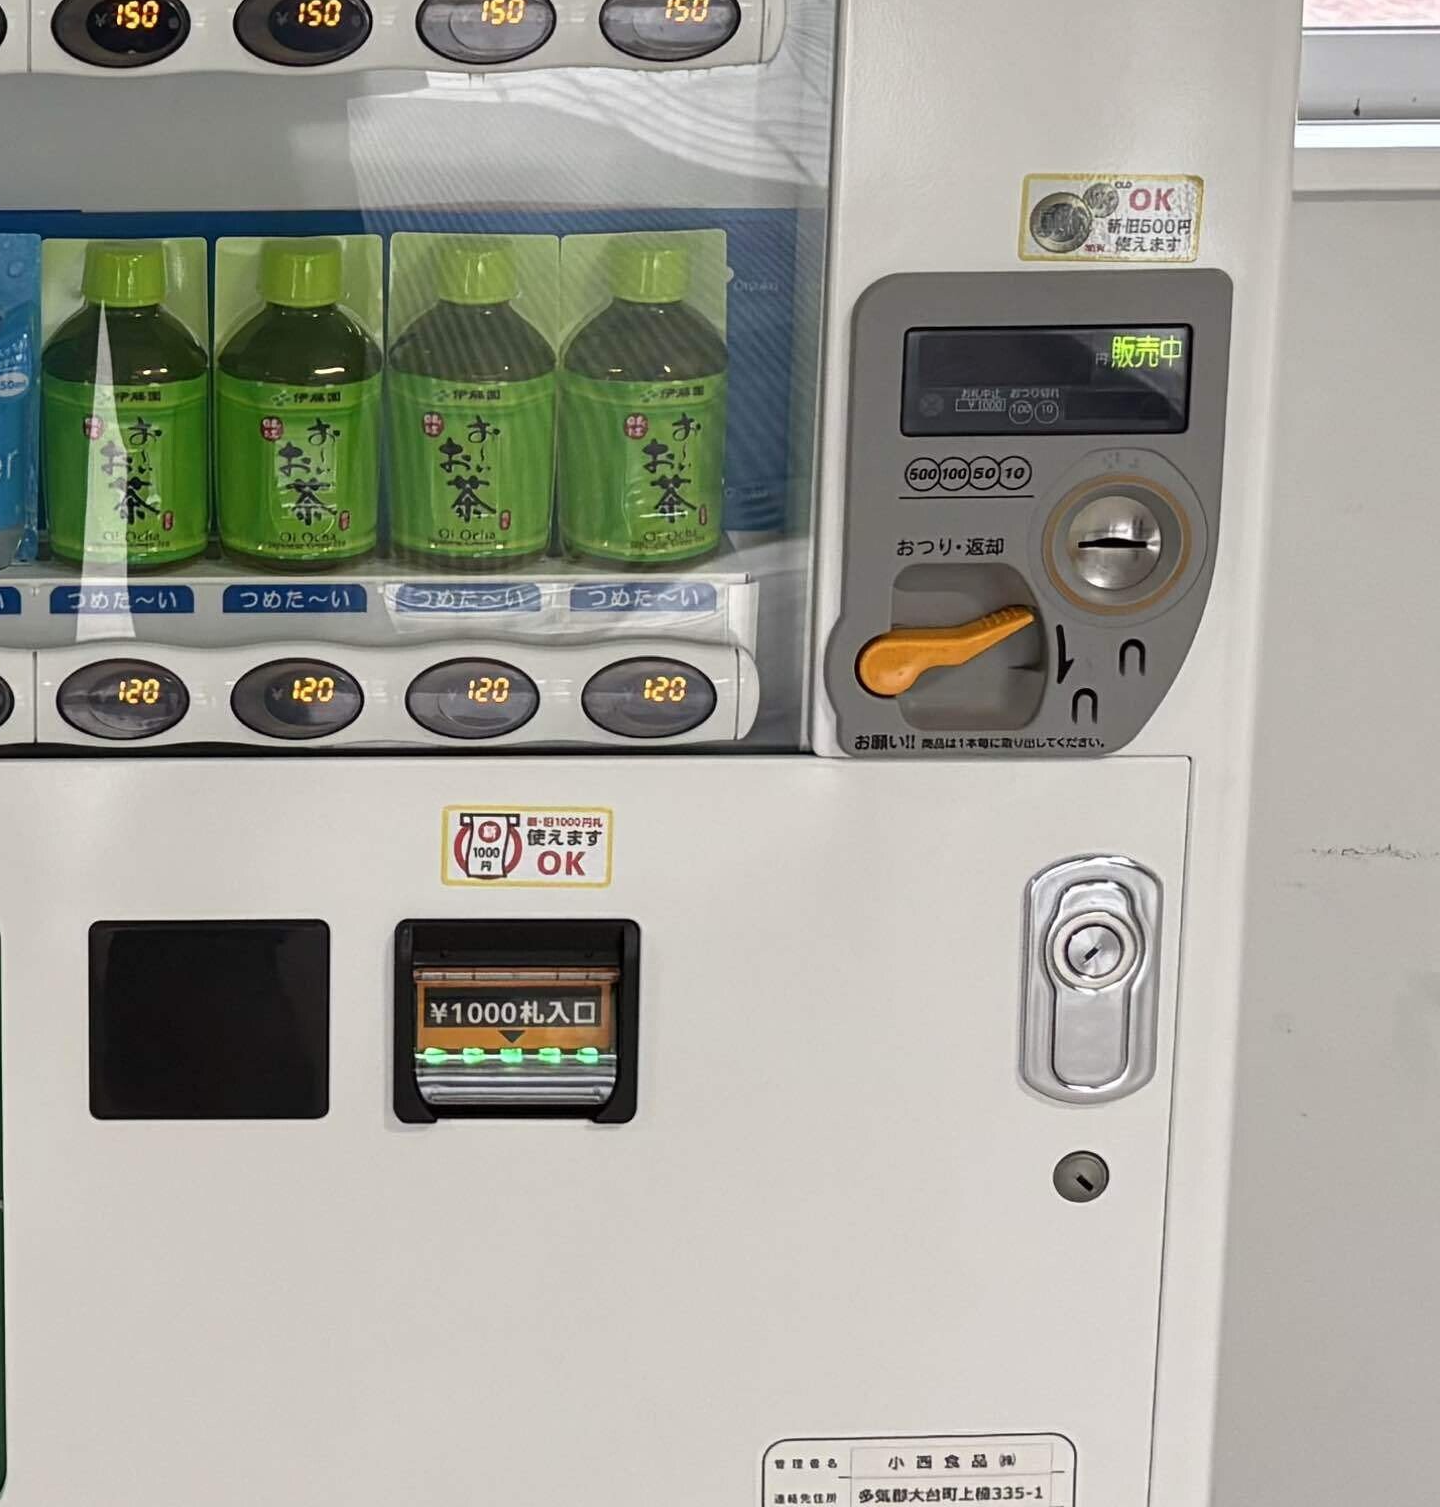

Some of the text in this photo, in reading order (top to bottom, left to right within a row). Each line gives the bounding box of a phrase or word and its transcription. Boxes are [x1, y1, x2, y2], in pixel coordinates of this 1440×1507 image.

[117, 1, 158, 28] 150
[299, 0, 341, 26] 150
[1129, 188, 1175, 211] OK
[1111, 335, 1182, 367] 販売中
[909, 467, 1025, 480] 500 100 50 10
[119, 679, 159, 703] 120
[293, 678, 333, 702] 120
[470, 678, 508, 702] 120
[645, 677, 685, 701] 120
[527, 829, 603, 846] 使えます
[473, 847, 500, 858] 1000
[537, 851, 587, 876] OK
